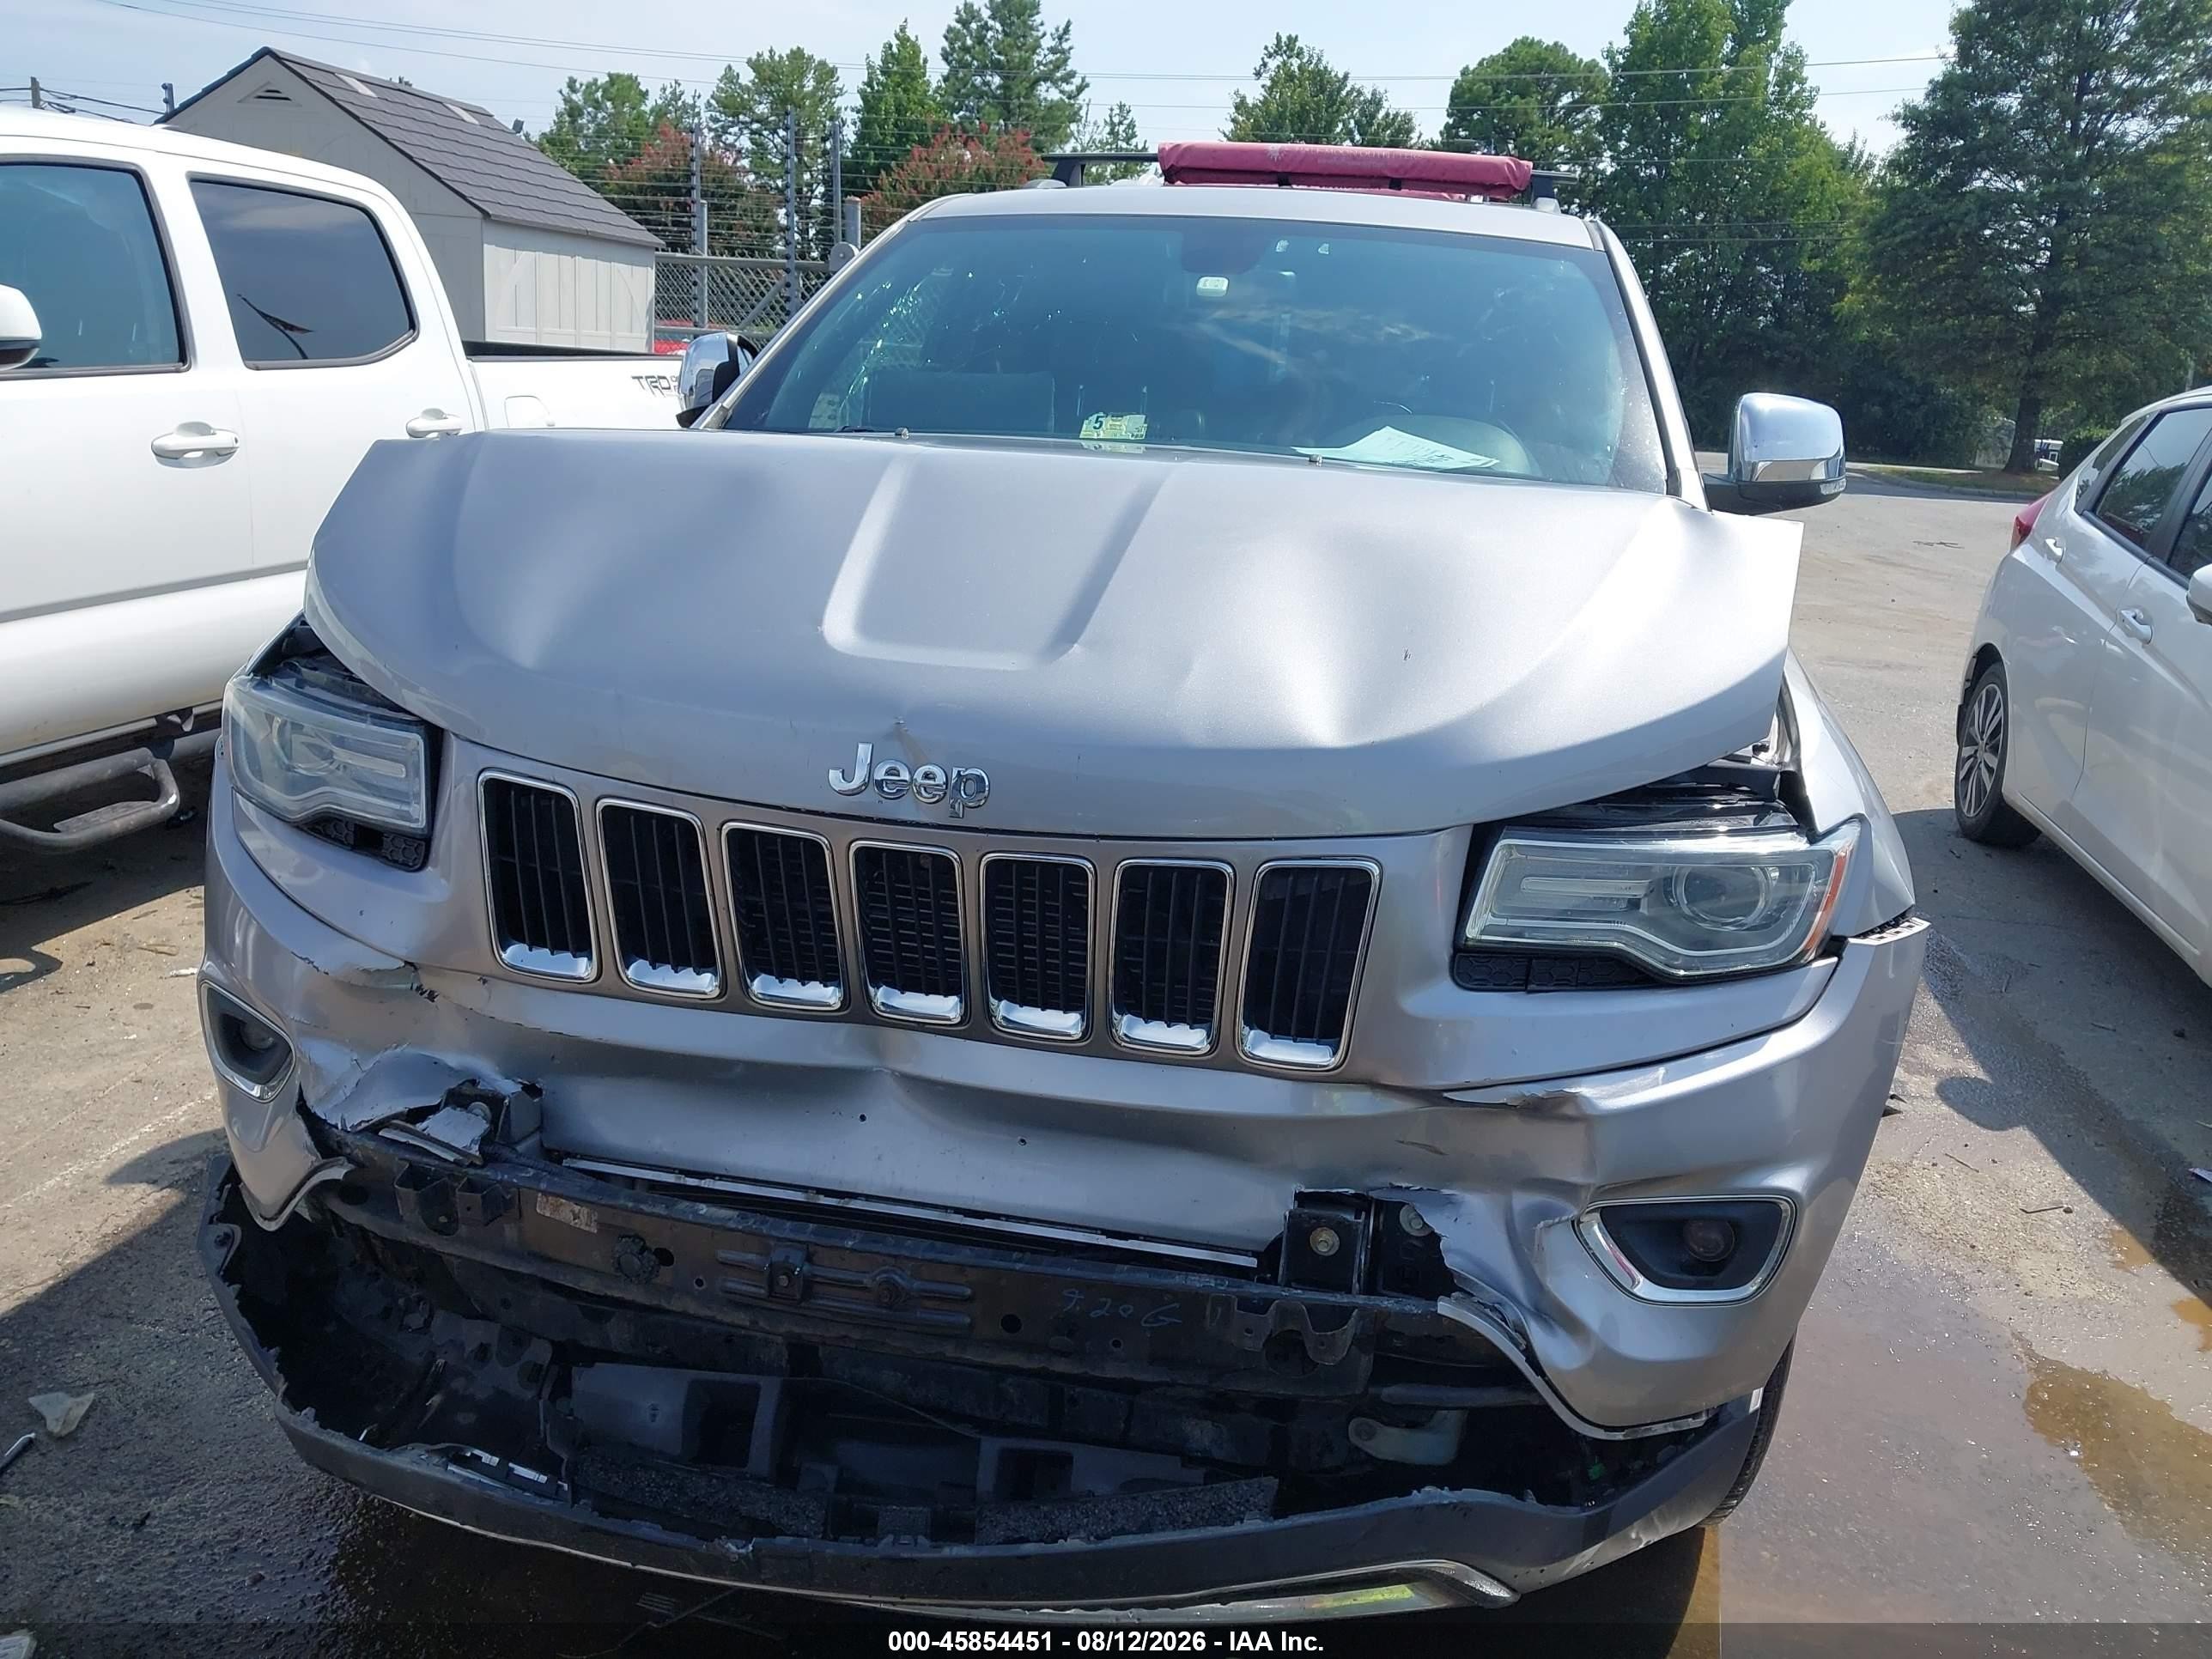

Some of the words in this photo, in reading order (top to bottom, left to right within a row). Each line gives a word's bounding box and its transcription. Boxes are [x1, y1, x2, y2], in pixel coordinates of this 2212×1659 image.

[631, 375, 671, 398] TRD
[1092, 415, 1106, 430] 5
[828, 742, 990, 818] Jeep
